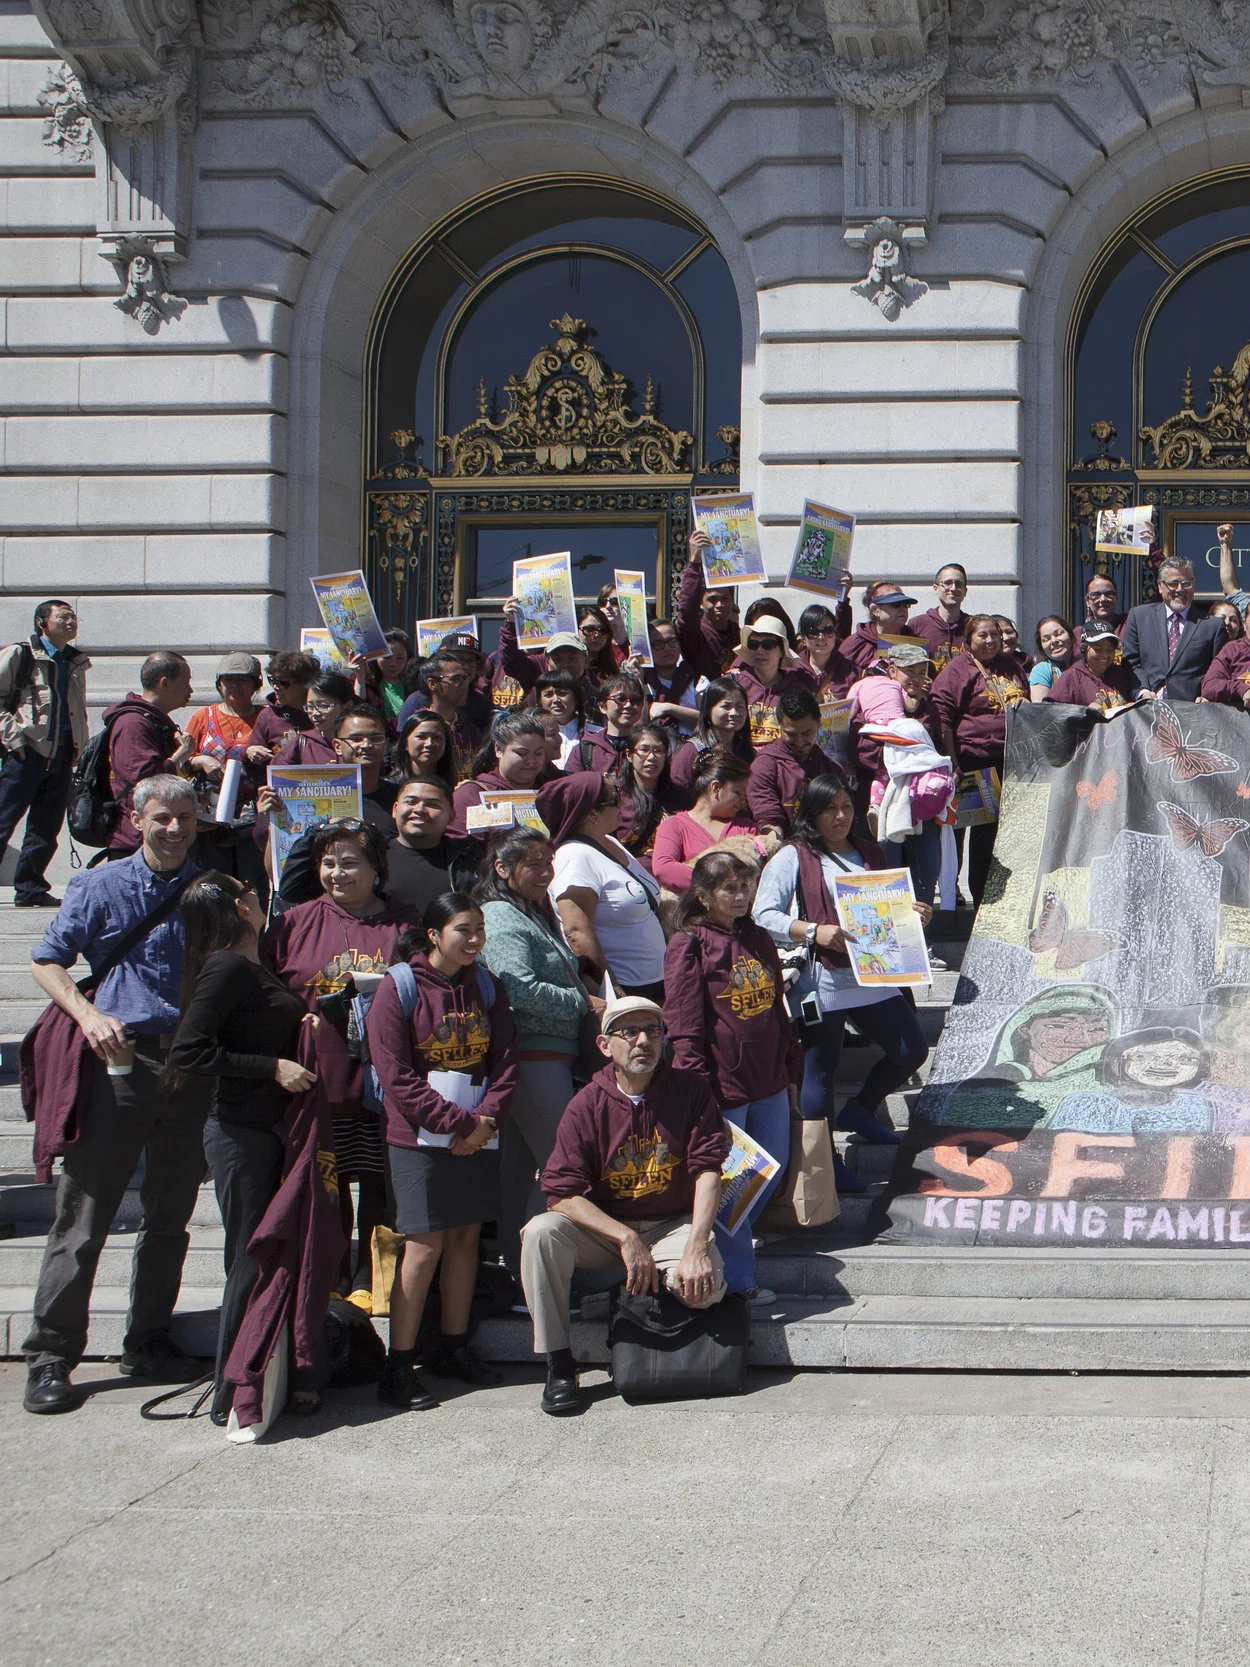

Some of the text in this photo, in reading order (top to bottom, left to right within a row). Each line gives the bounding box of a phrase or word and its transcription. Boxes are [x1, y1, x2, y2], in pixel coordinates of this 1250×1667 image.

[711, 507, 751, 519] SANCTUARY!
[493, 695, 524, 706] SFILE
[278, 785, 353, 798] MY SANCTUARY!
[842, 892, 857, 903] MY
[857, 888, 906, 902] SANCTUARY!
[731, 986, 777, 1011] SFILEN
[609, 1167, 673, 1190] SFILEN
[718, 1152, 759, 1214] MY SANCTUARY!
[923, 1197, 1109, 1239] KEEPING
